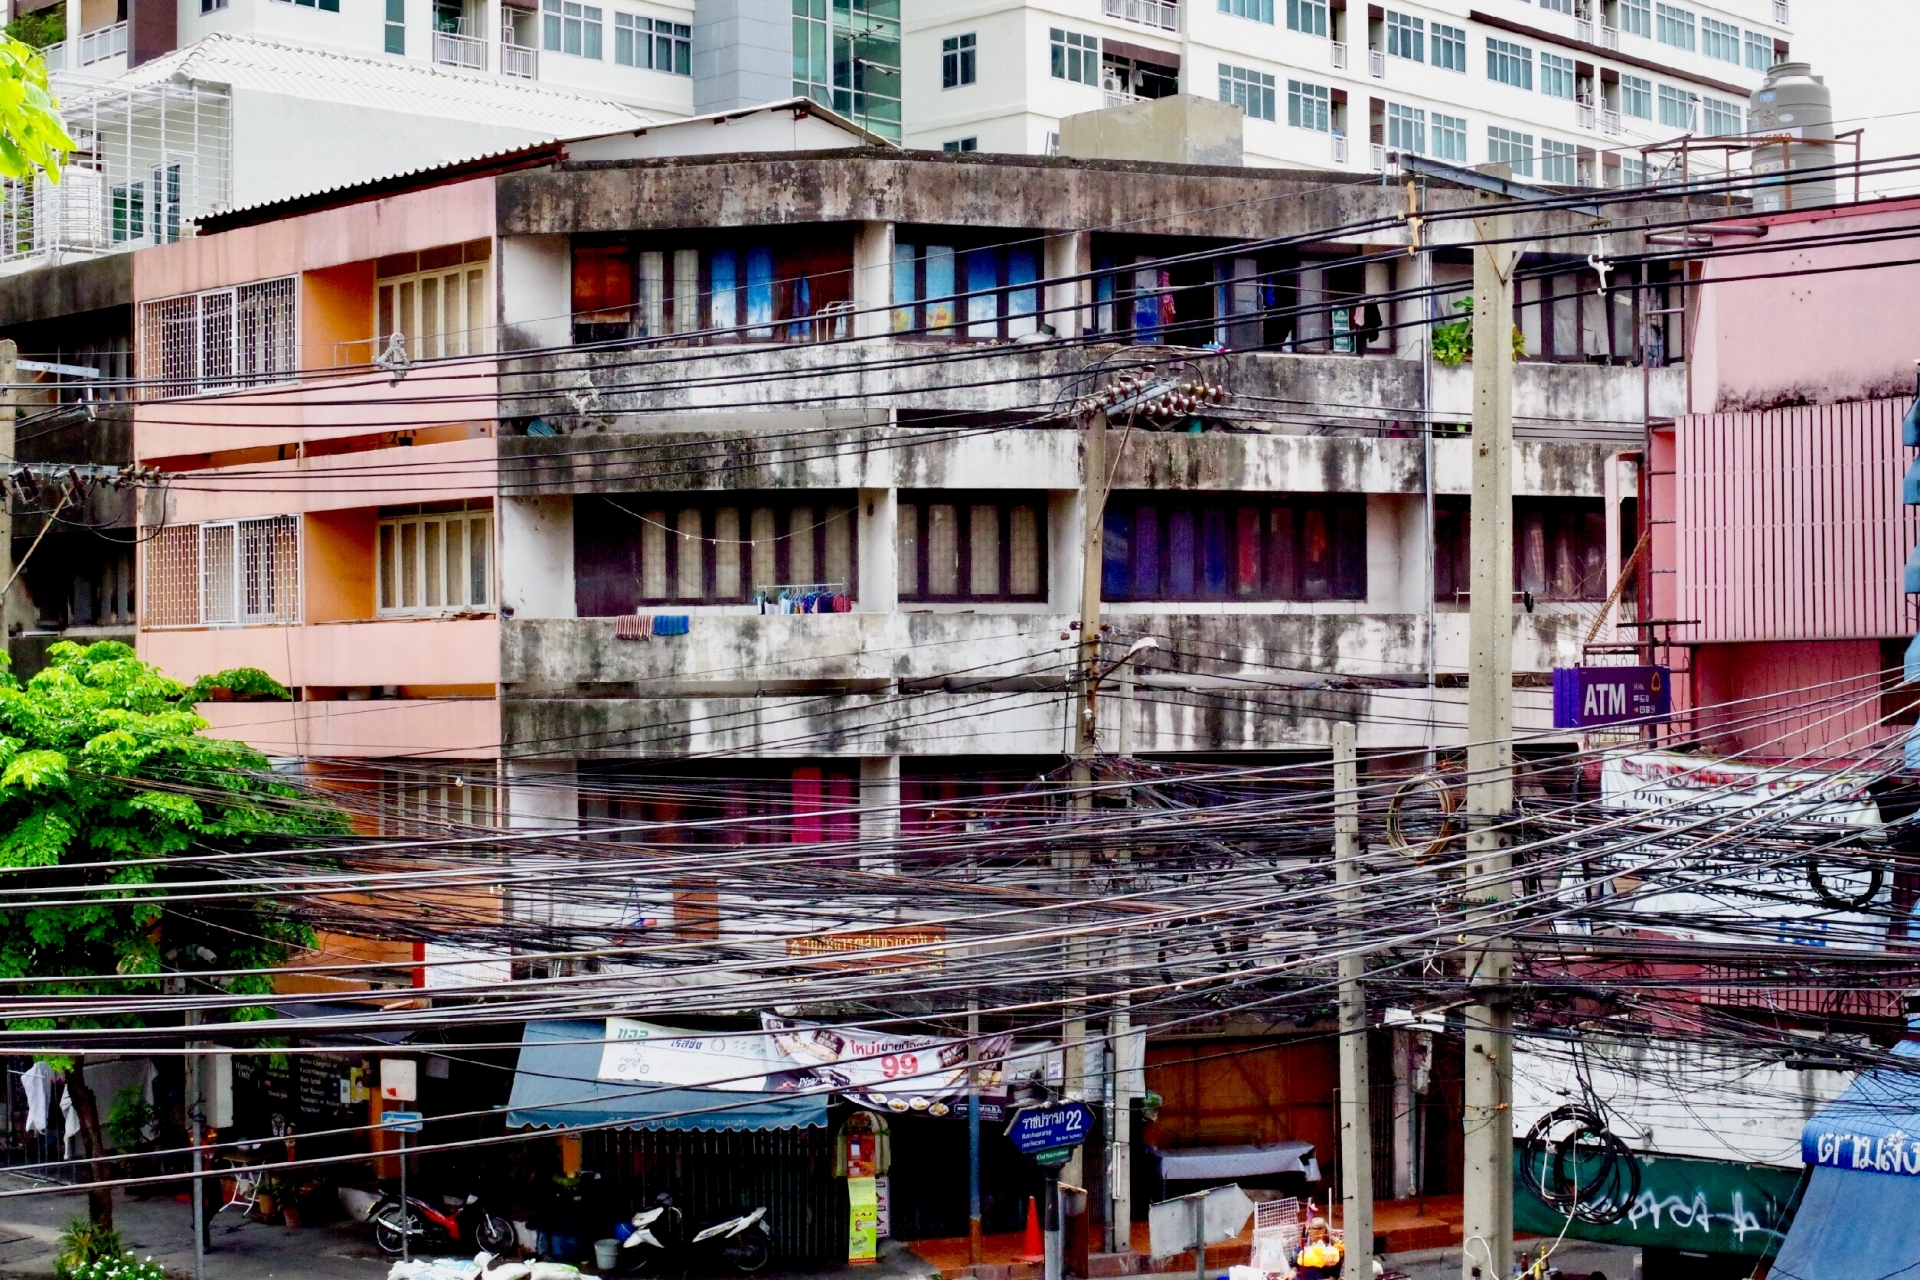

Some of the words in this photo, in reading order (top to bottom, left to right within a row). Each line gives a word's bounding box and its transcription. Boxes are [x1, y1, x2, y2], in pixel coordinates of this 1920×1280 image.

[1584, 683, 1626, 716] ATM
[817, 1038, 838, 1051] BOX
[820, 1030, 837, 1042] MY
[942, 1044, 958, 1059] MY
[880, 1053, 918, 1079] 99
[1066, 1109, 1082, 1131] 22
